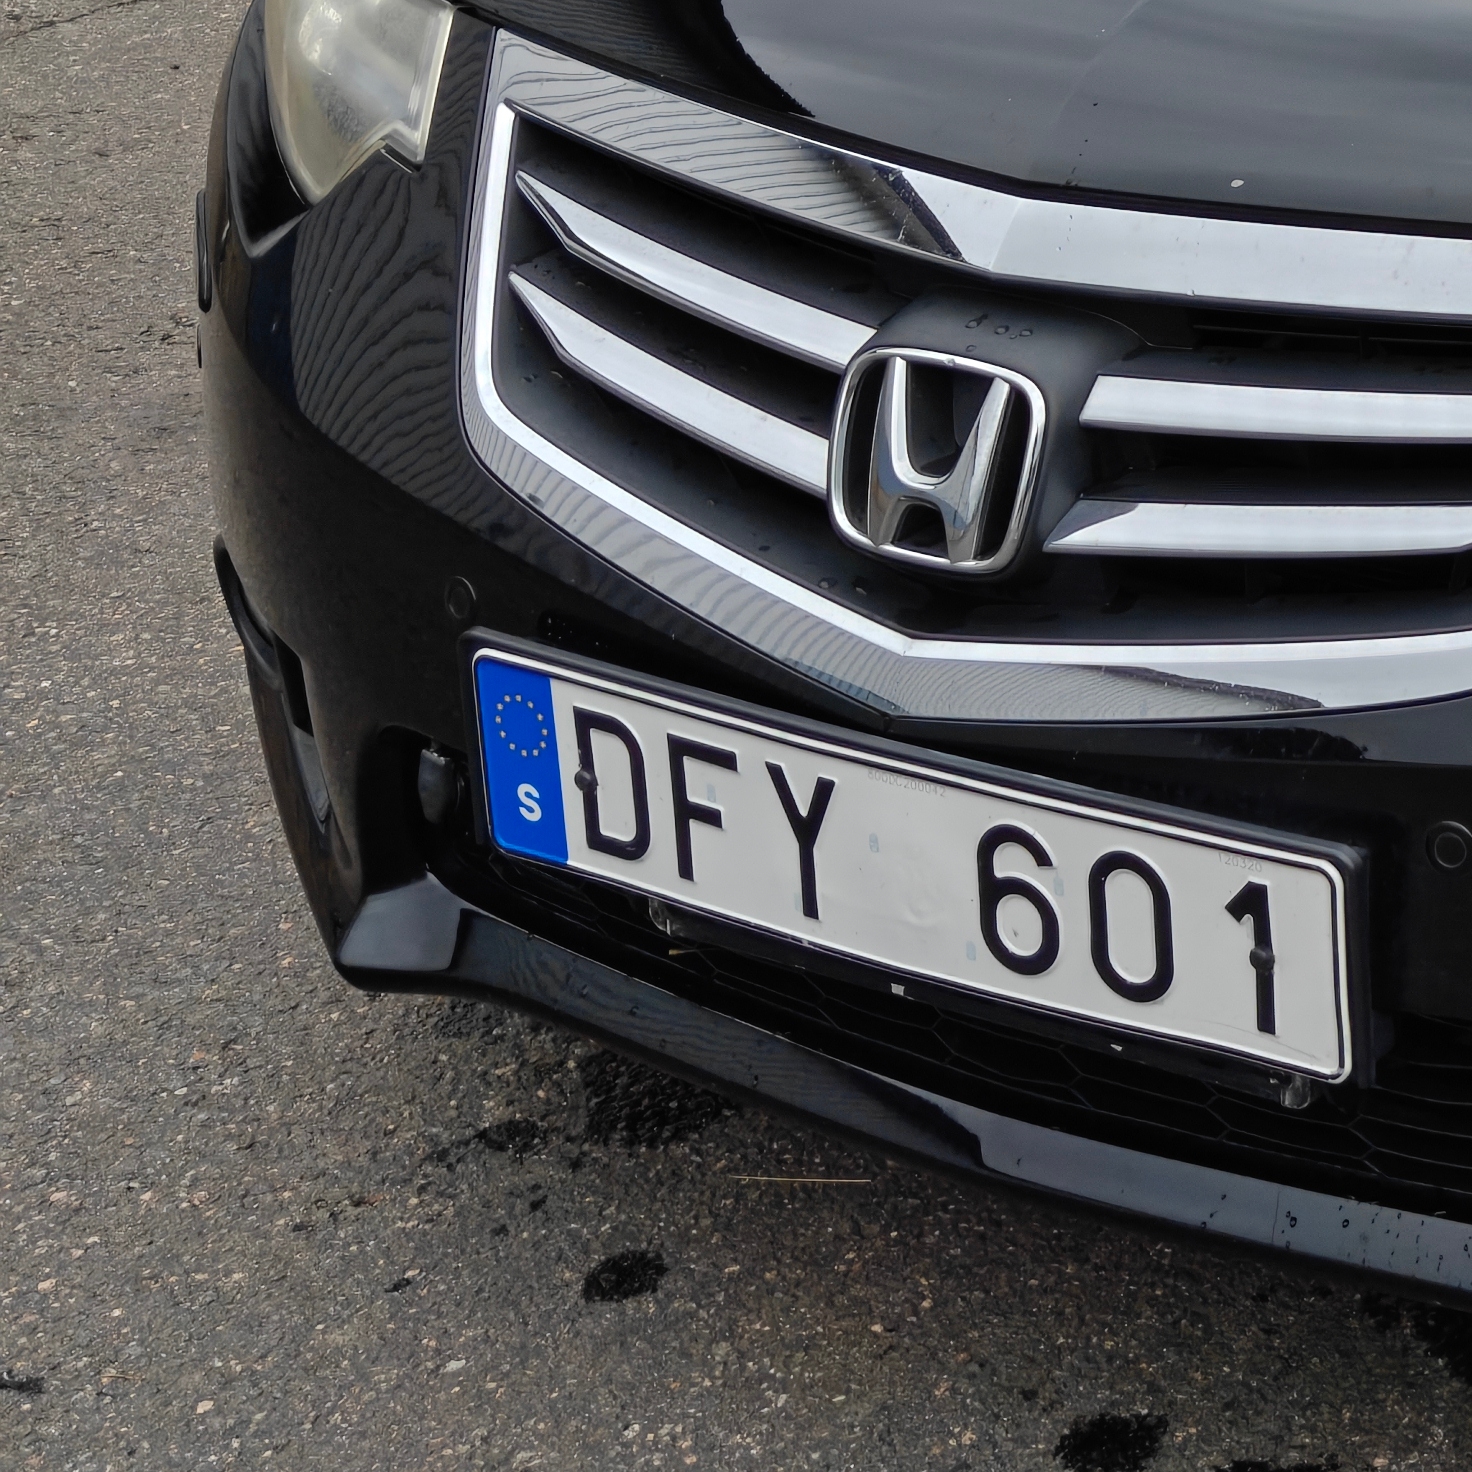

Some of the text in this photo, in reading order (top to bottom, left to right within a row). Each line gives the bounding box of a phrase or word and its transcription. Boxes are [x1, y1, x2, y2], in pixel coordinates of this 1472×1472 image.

[518, 782, 543, 824] S
[572, 705, 1278, 1036] DFY 601
